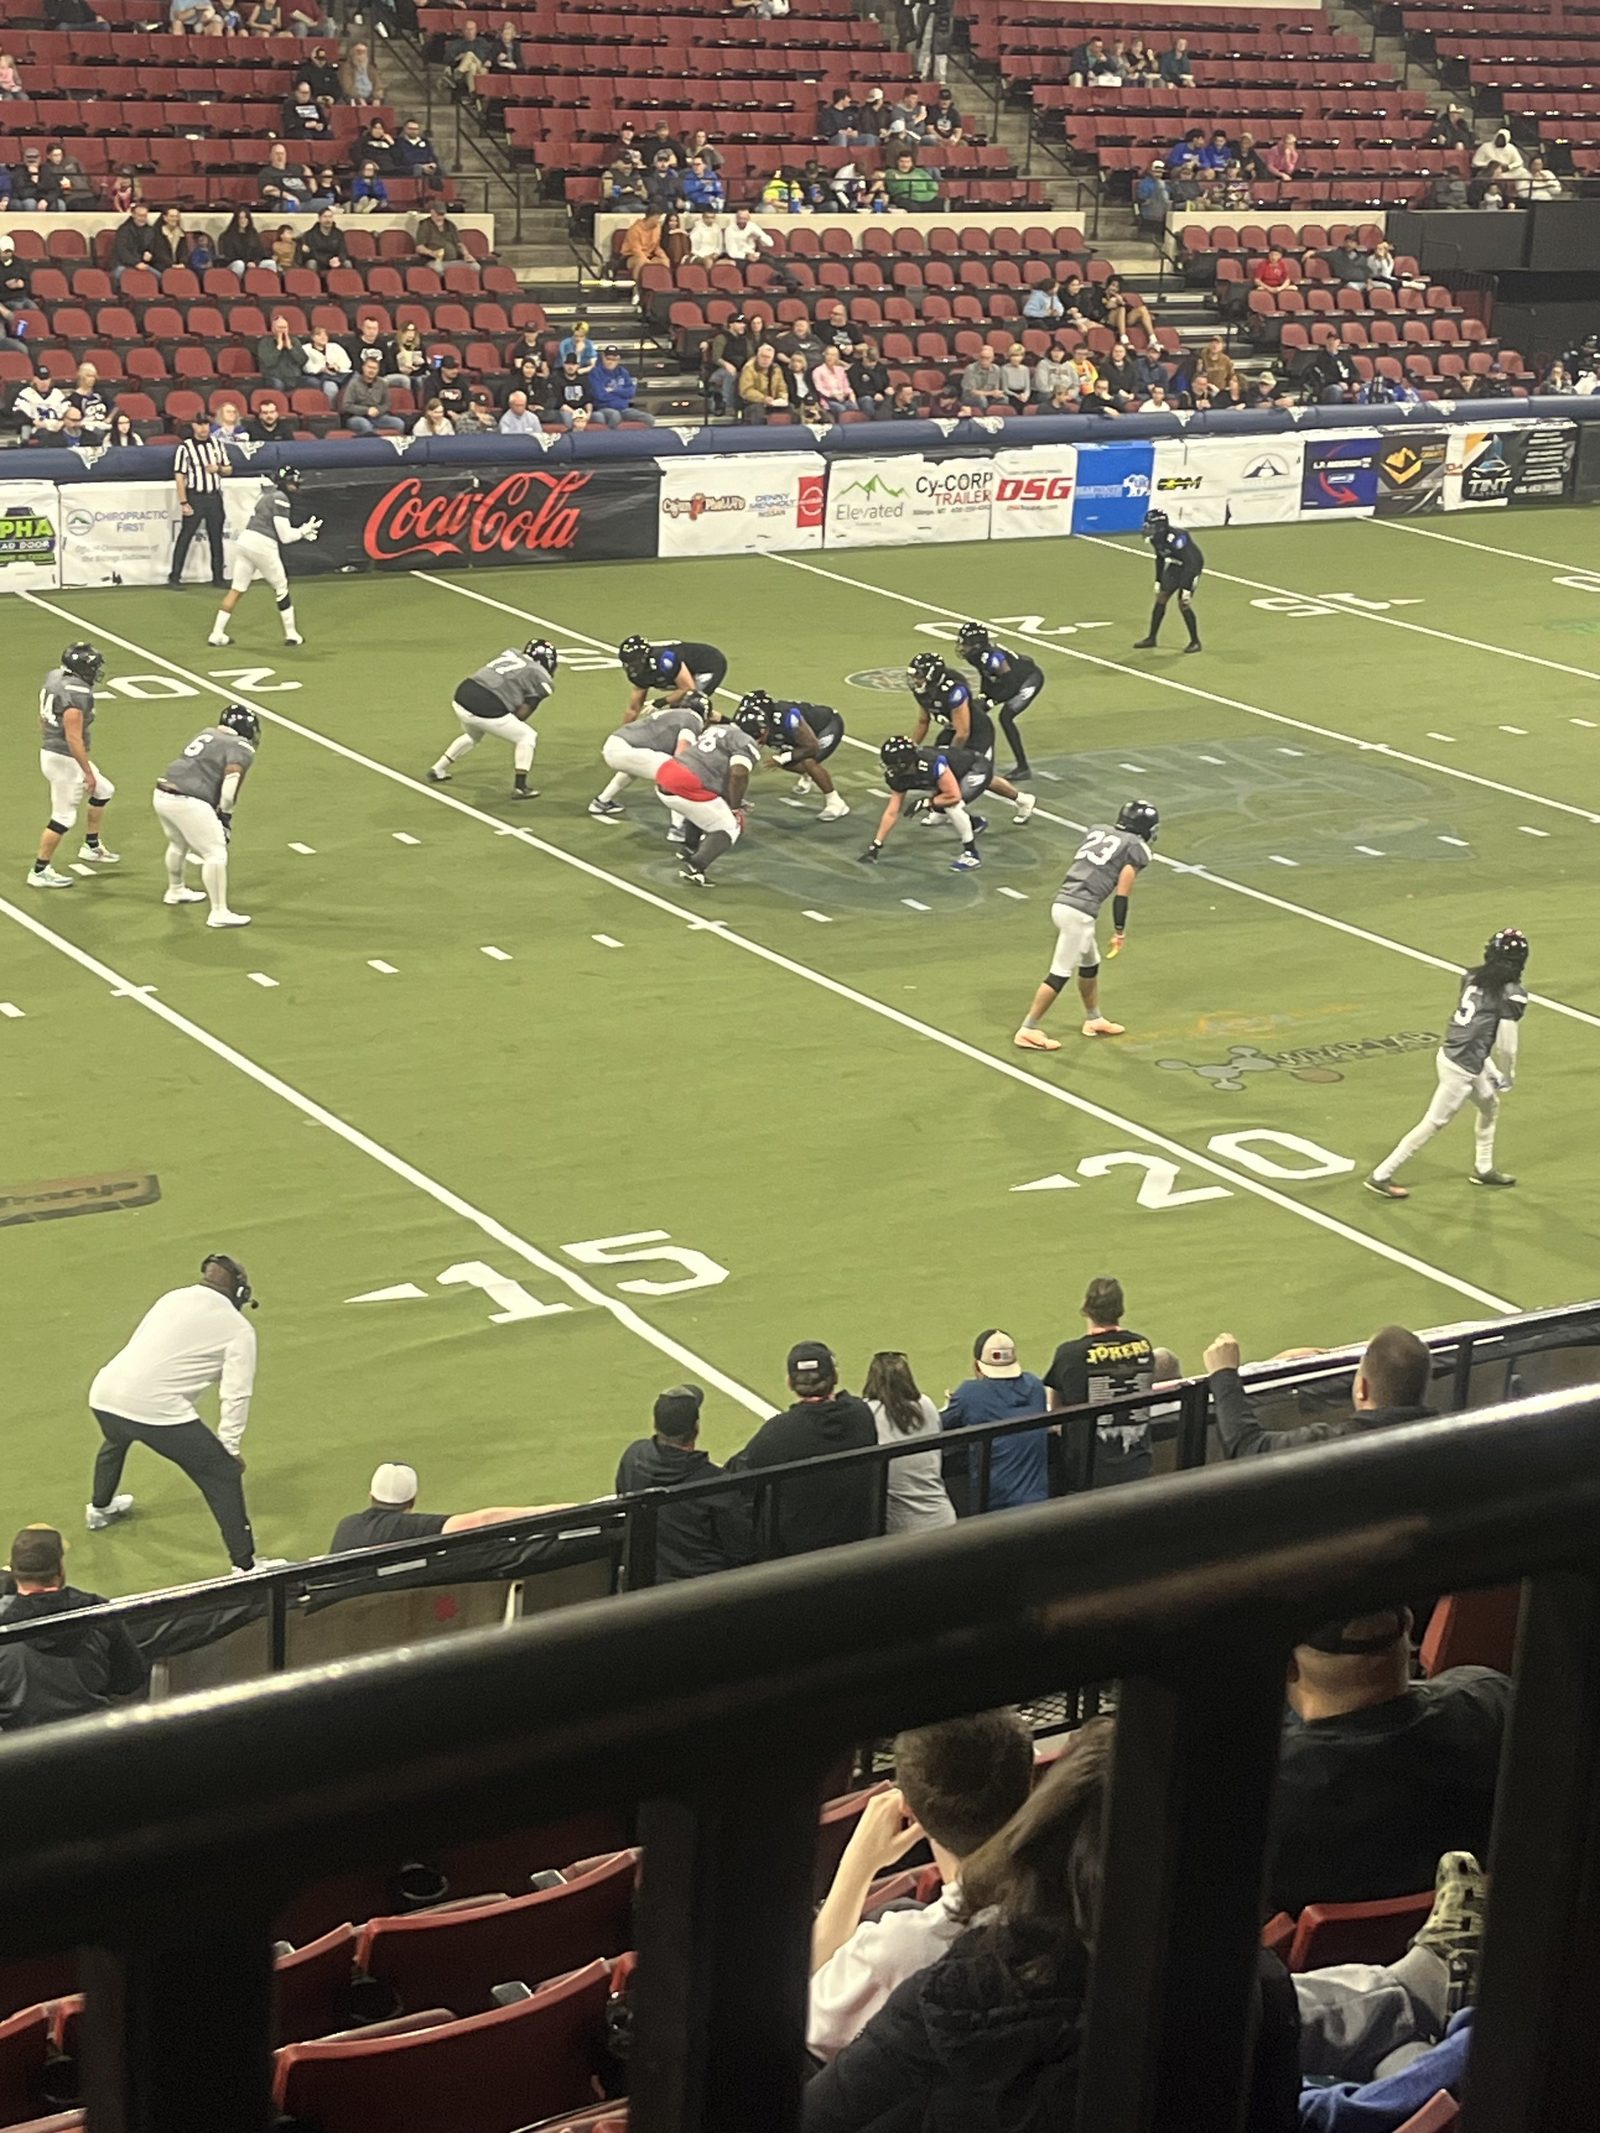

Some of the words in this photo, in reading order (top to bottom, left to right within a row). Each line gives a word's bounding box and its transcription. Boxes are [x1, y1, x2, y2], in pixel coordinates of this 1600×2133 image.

[916, 472, 993, 497] Cy-CORP
[995, 477, 1073, 501] DSG
[1468, 477, 1513, 493] TINT
[934, 489, 992, 506] TRAILER
[363, 470, 597, 560] Coca-Cola
[836, 502, 904, 520] Elevated
[1074, 831, 1122, 867] 23
[1454, 986, 1484, 1025] 5
[1273, 1041, 1363, 1066] WRAP
[1076, 1128, 1356, 1209] 20
[436, 1229, 730, 1324] 15
[1086, 1340, 1150, 1364] JOKERS
